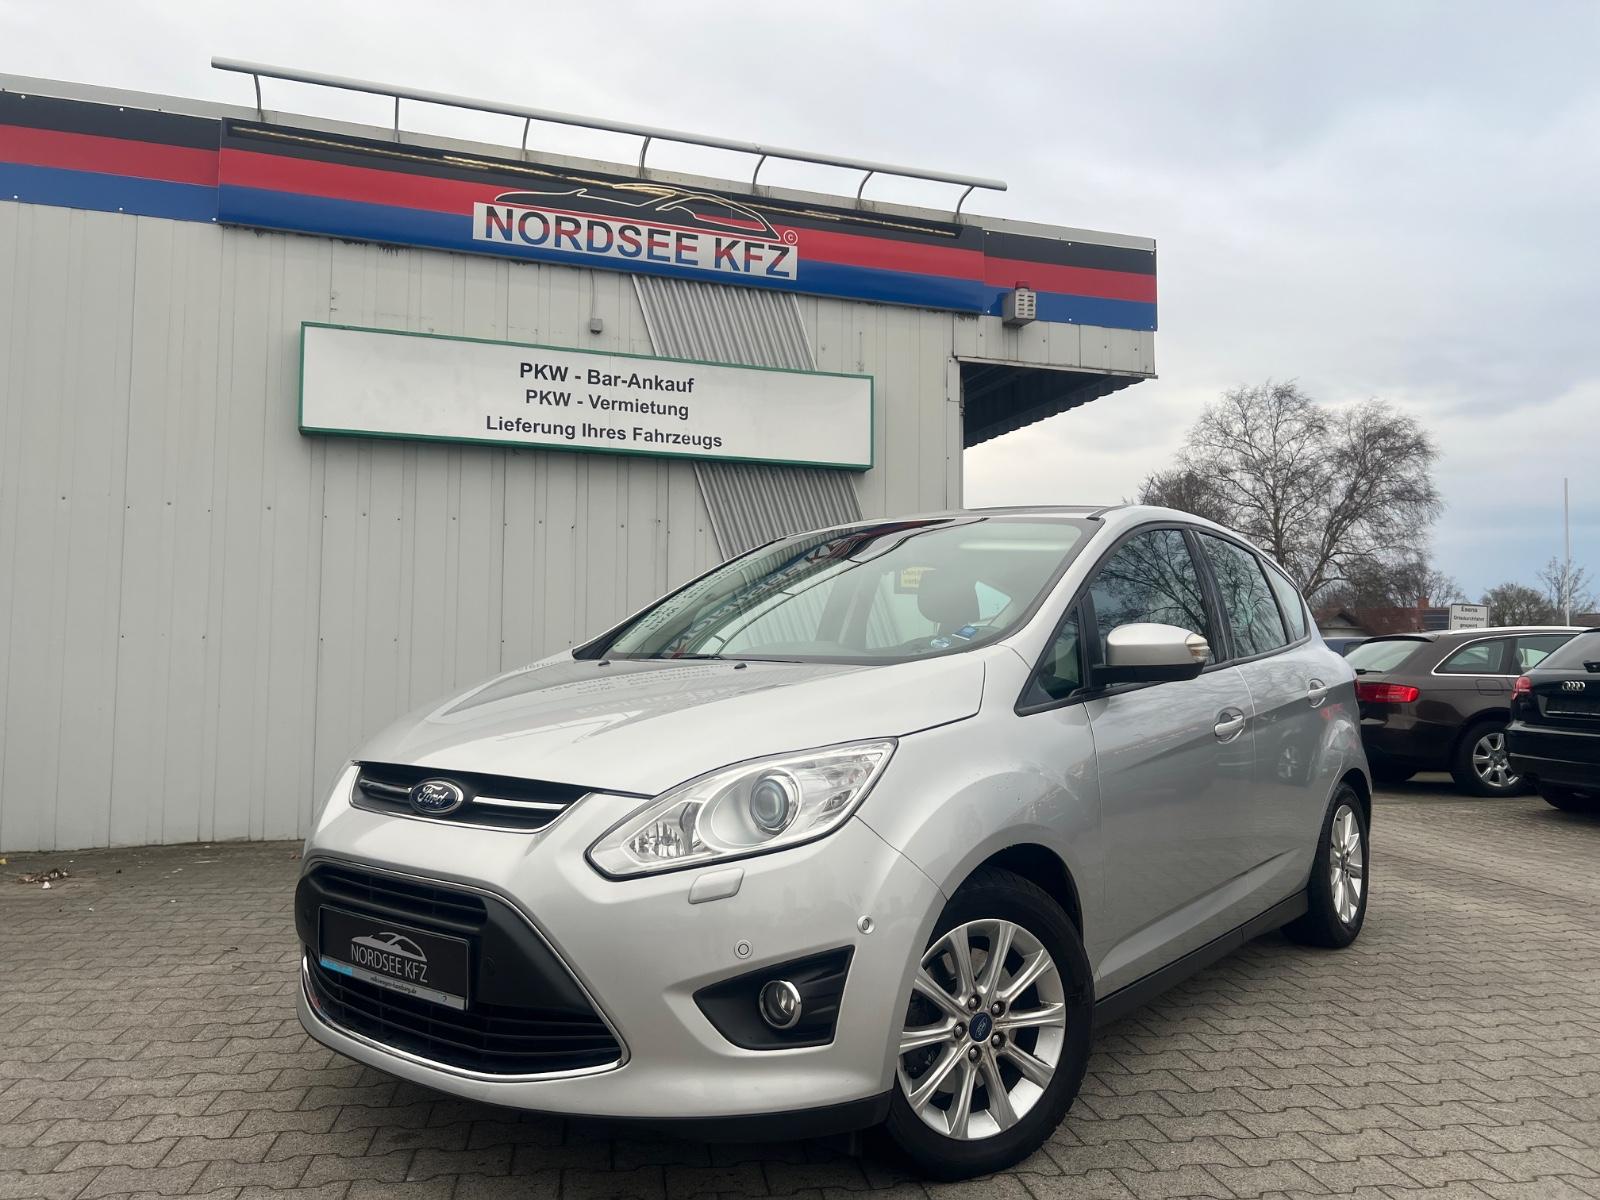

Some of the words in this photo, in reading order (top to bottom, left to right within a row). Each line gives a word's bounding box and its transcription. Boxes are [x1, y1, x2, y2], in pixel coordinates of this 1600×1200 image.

[485, 205, 699, 265] NORDSEE
[714, 237, 790, 278] KFZ
[520, 362, 569, 382] PKW
[587, 369, 695, 393] Bar-Ankauf
[525, 389, 571, 407] PKW
[588, 394, 689, 420] Vermietung
[486, 415, 576, 439] Lieferung
[582, 423, 626, 441] Ihres
[633, 427, 723, 449] Fahrzeugs
[417, 784, 449, 805] Ford
[351, 944, 402, 976] NORDSEE
[405, 960, 428, 983] KFZ
